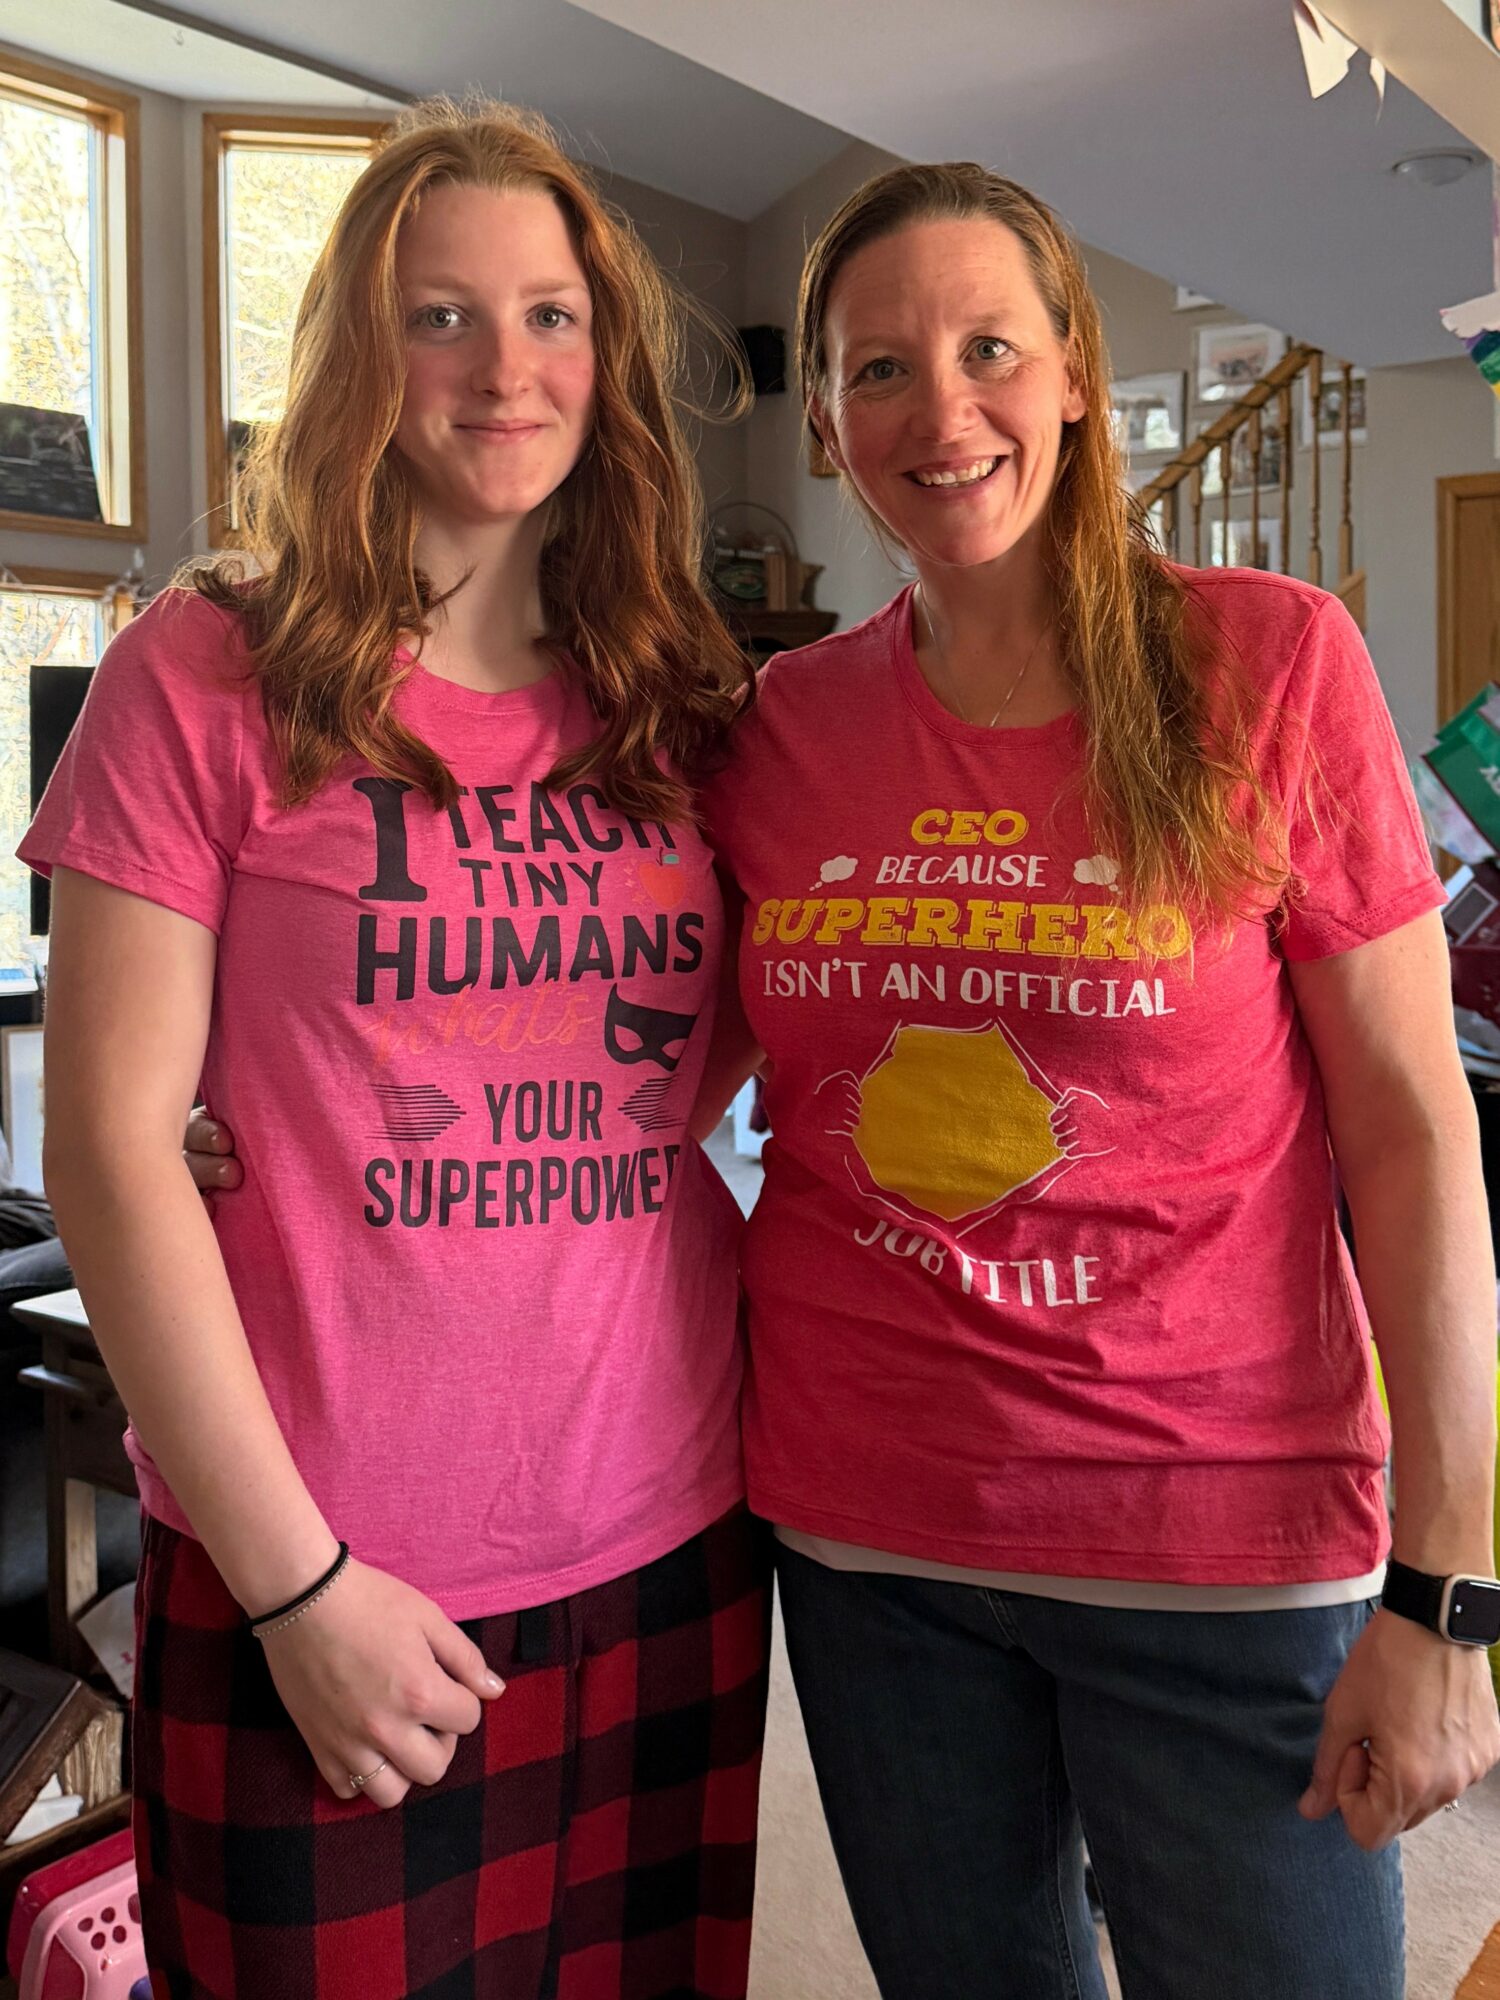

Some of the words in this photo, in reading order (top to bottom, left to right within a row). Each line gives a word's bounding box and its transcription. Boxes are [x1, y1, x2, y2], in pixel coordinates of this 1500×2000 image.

[352, 776, 428, 902] I
[911, 809, 1029, 846] CEO
[459, 858, 604, 907] TINY
[875, 854, 1050, 888] BECAUSE
[356, 912, 705, 1006] HUMANS
[752, 898, 1193, 961] SUPERHERO
[762, 957, 867, 999] ISN'T
[881, 962, 946, 1002] AN
[960, 967, 1177, 1018] OFFICIAL
[483, 1080, 603, 1145] YOUR
[854, 1219, 949, 1276] JOB
[955, 1246, 1102, 1308] TITLE
